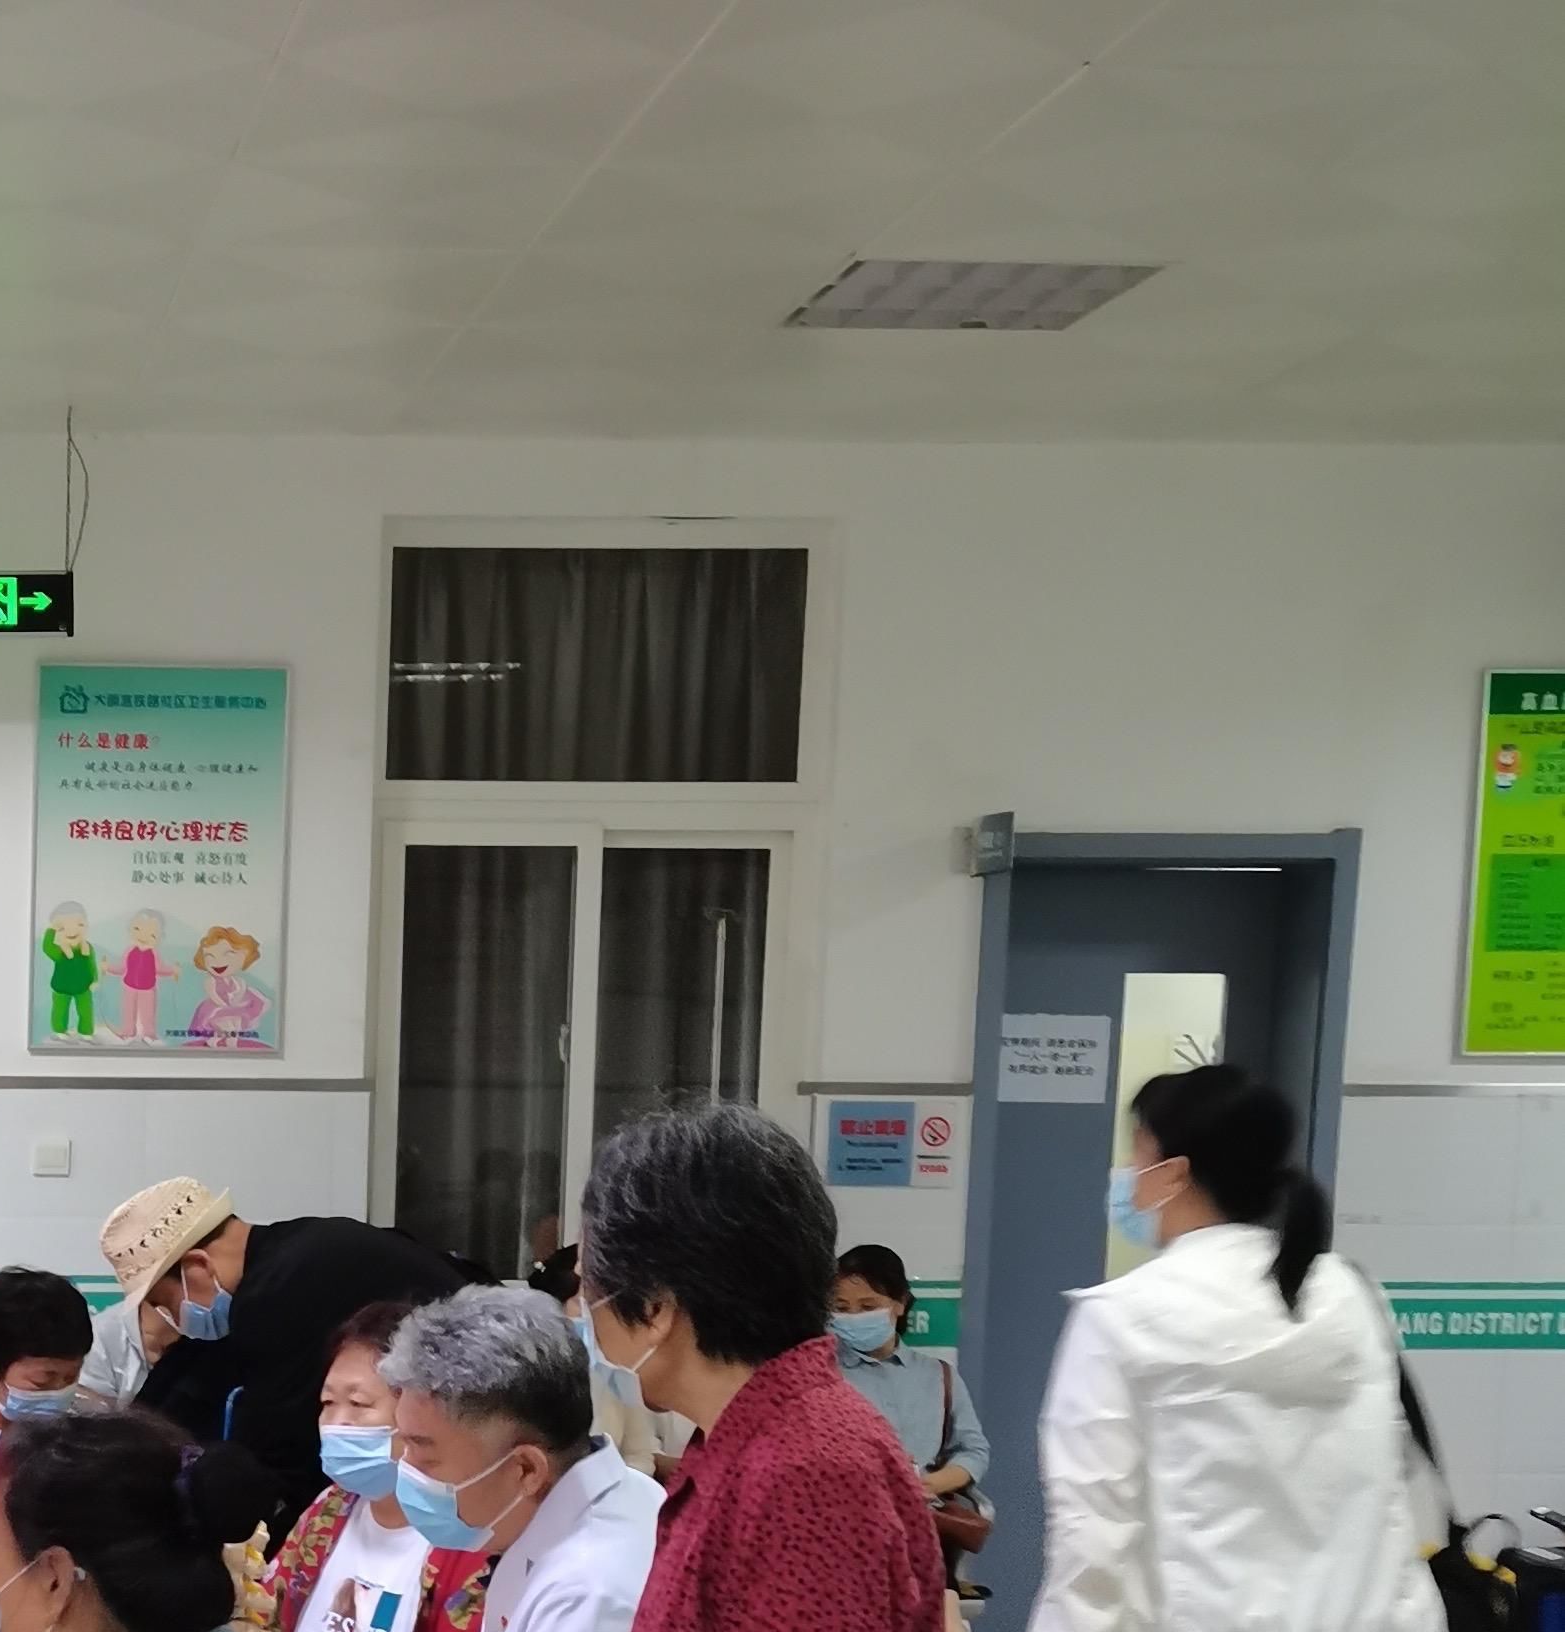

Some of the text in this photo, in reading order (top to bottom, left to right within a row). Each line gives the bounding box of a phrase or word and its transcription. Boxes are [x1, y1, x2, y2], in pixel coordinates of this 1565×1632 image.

[68, 819, 249, 842] 保持良好心理状态
[1447, 1311, 1554, 1335] DISTRICT
